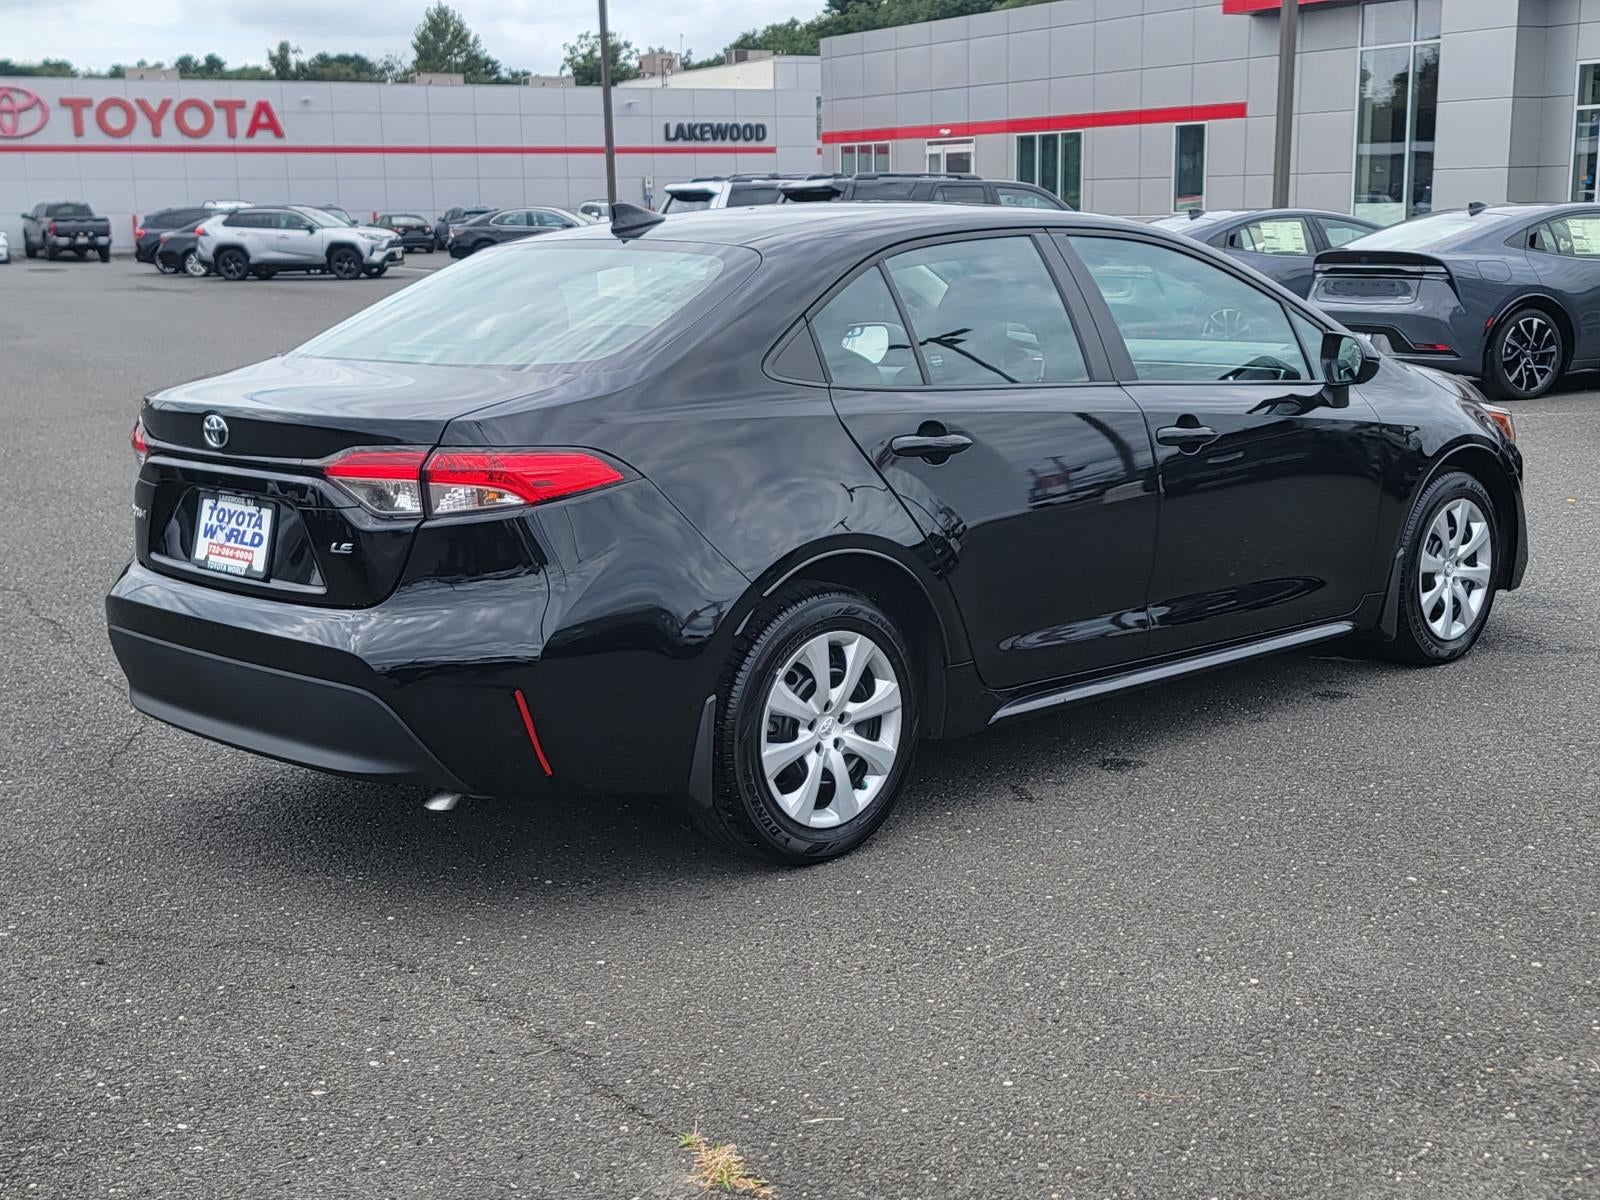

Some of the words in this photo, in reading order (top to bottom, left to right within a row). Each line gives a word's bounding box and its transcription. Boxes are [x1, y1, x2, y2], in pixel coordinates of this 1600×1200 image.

[59, 97, 285, 138] TOYOTA
[664, 122, 767, 142] LAKEWOOD
[208, 505, 264, 530] TOYOTA
[203, 522, 264, 548] WRLD
[330, 542, 354, 554] LE
[207, 561, 227, 572] TOYOTA
[227, 564, 246, 575] WORLD
